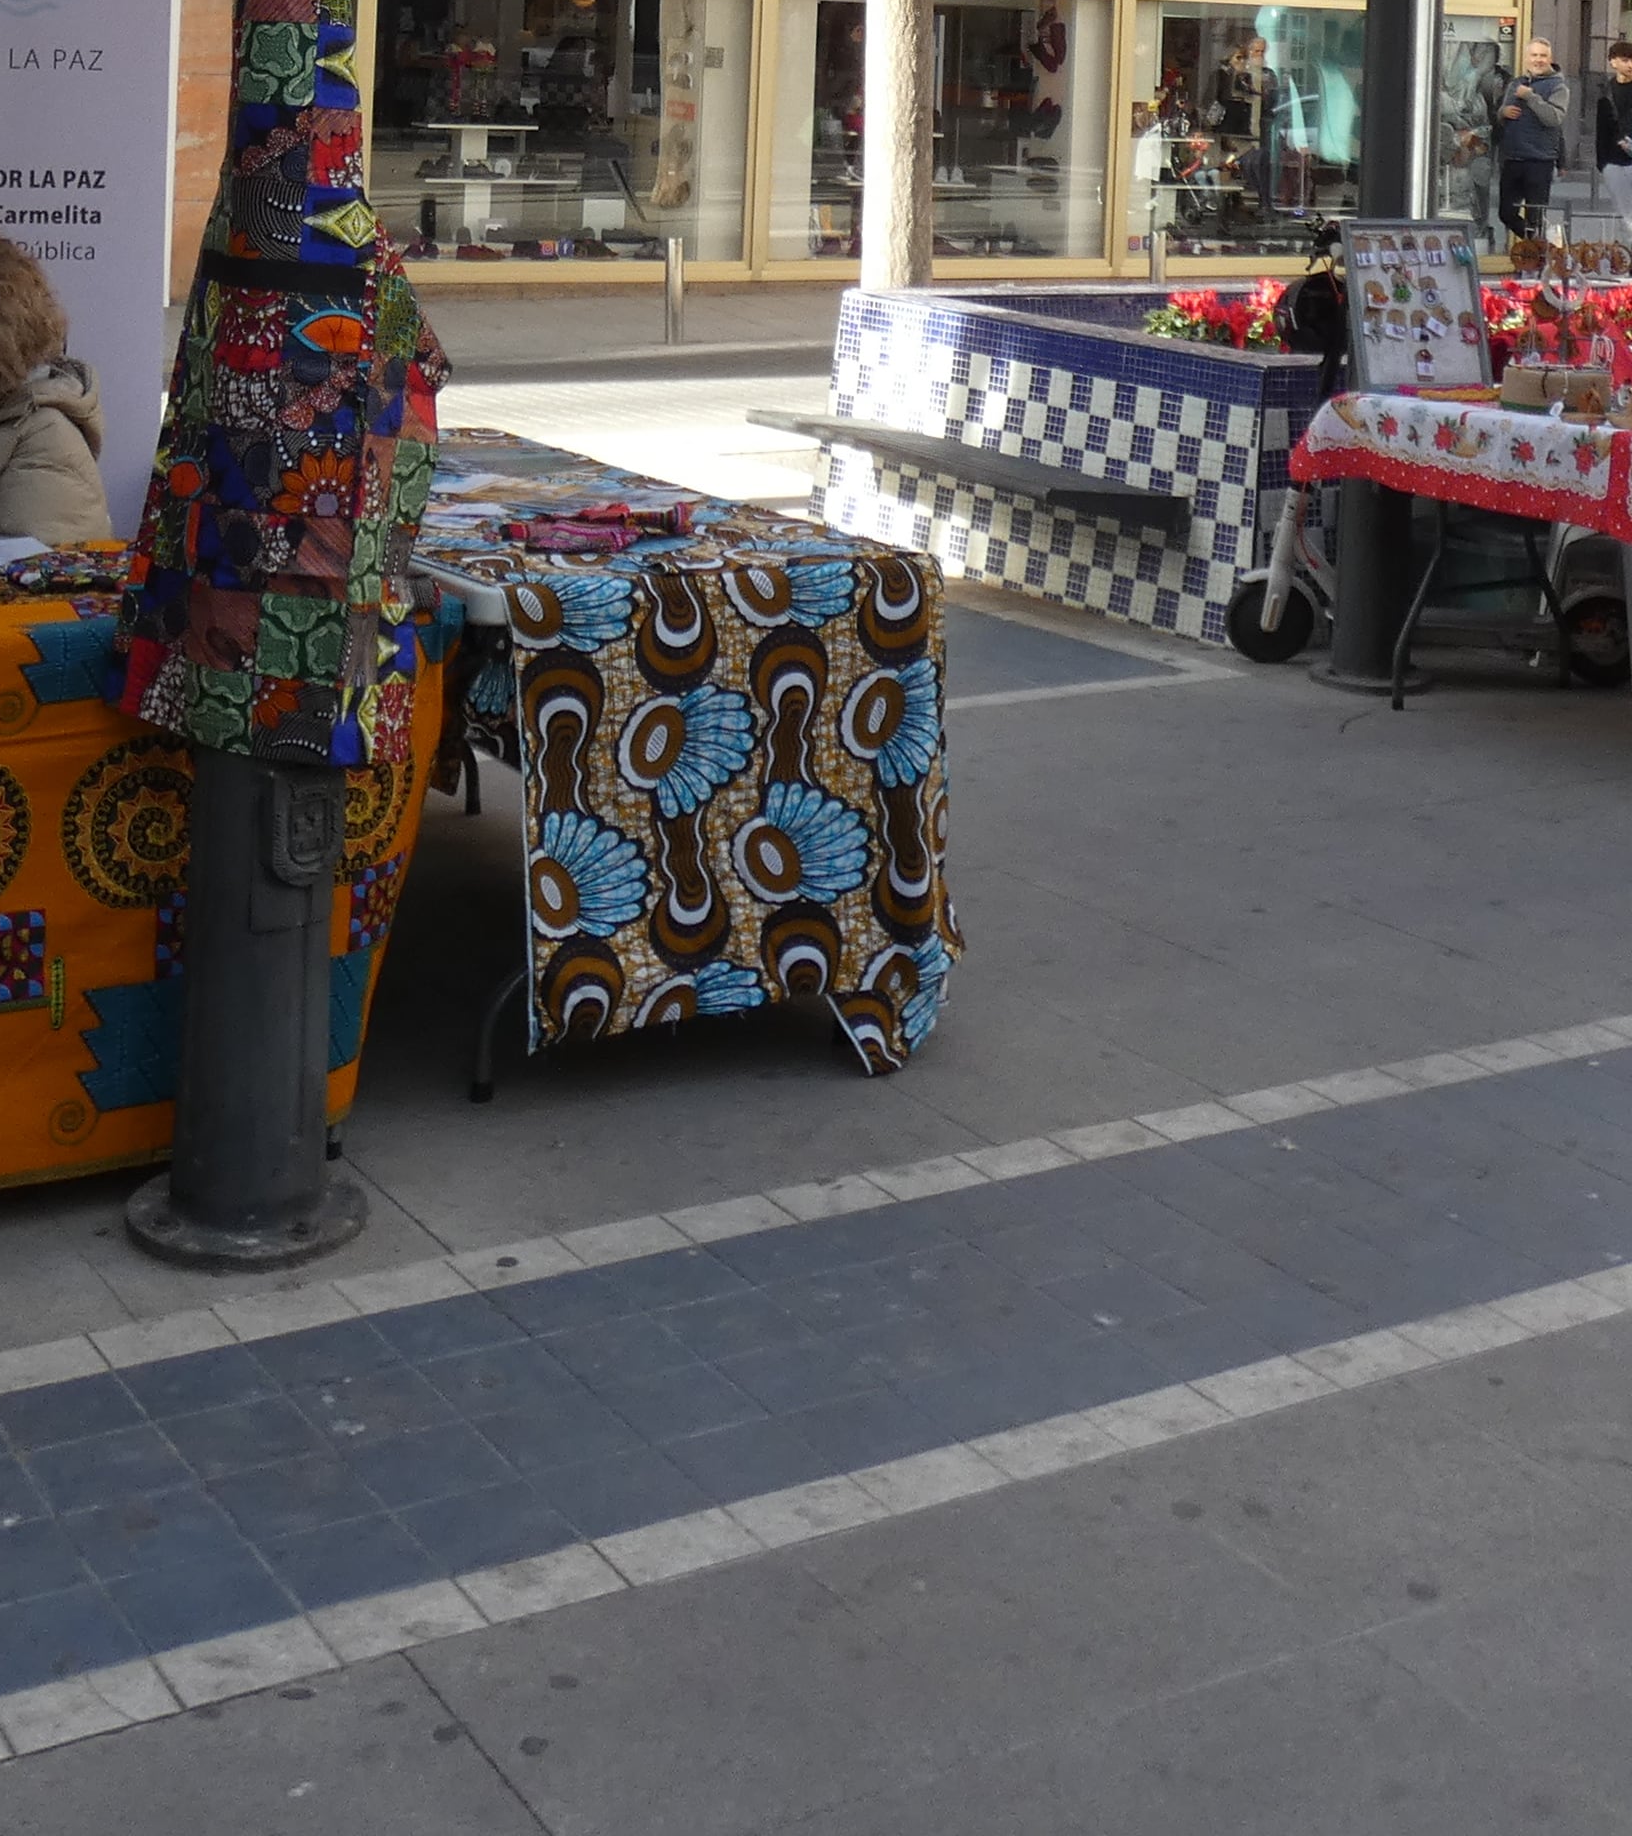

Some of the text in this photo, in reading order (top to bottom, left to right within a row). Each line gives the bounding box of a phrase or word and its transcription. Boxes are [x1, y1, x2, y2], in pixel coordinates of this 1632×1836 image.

[9, 49, 41, 70] LA
[53, 50, 104, 71] PAZ
[28, 169, 56, 189] LA
[62, 170, 106, 190] PAZ
